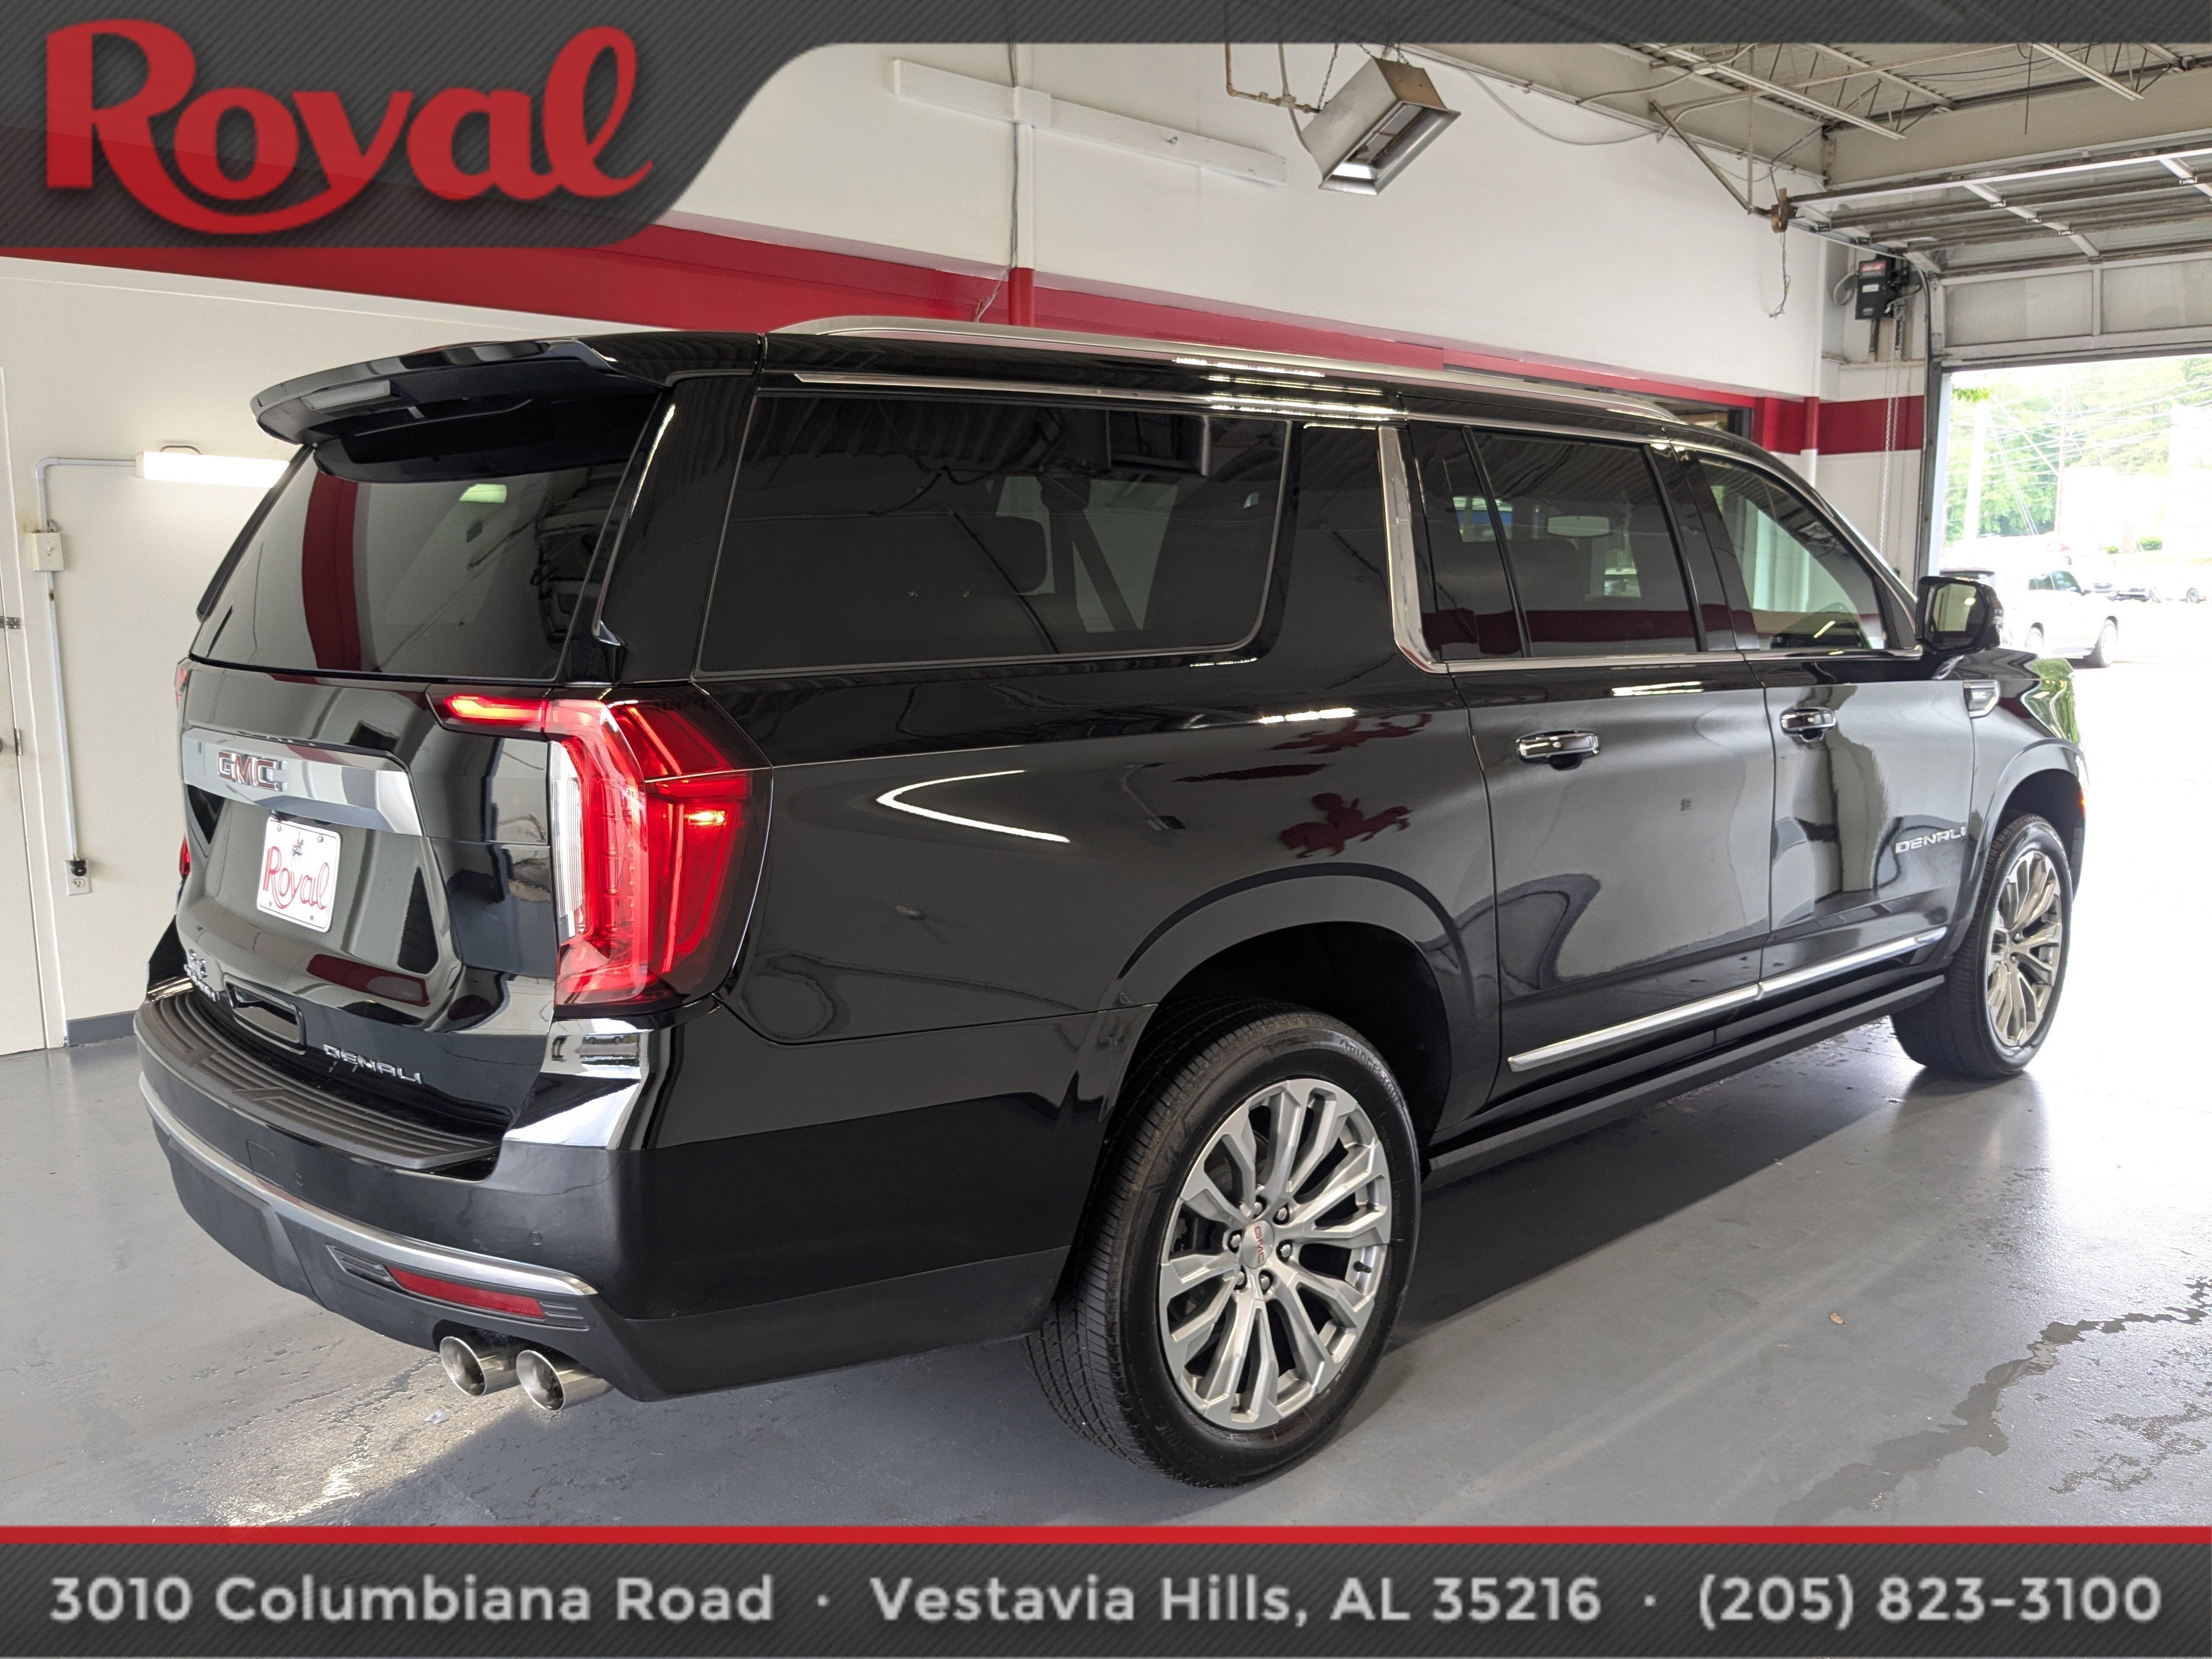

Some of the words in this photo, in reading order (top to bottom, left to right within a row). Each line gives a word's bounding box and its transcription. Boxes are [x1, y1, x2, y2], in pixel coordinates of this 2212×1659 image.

[218, 750, 287, 792] GMC
[1895, 826, 1966, 854] DENALI
[263, 846, 330, 909] Royal
[323, 1043, 422, 1085] DENALI
[1254, 1226, 1265, 1263] GMC
